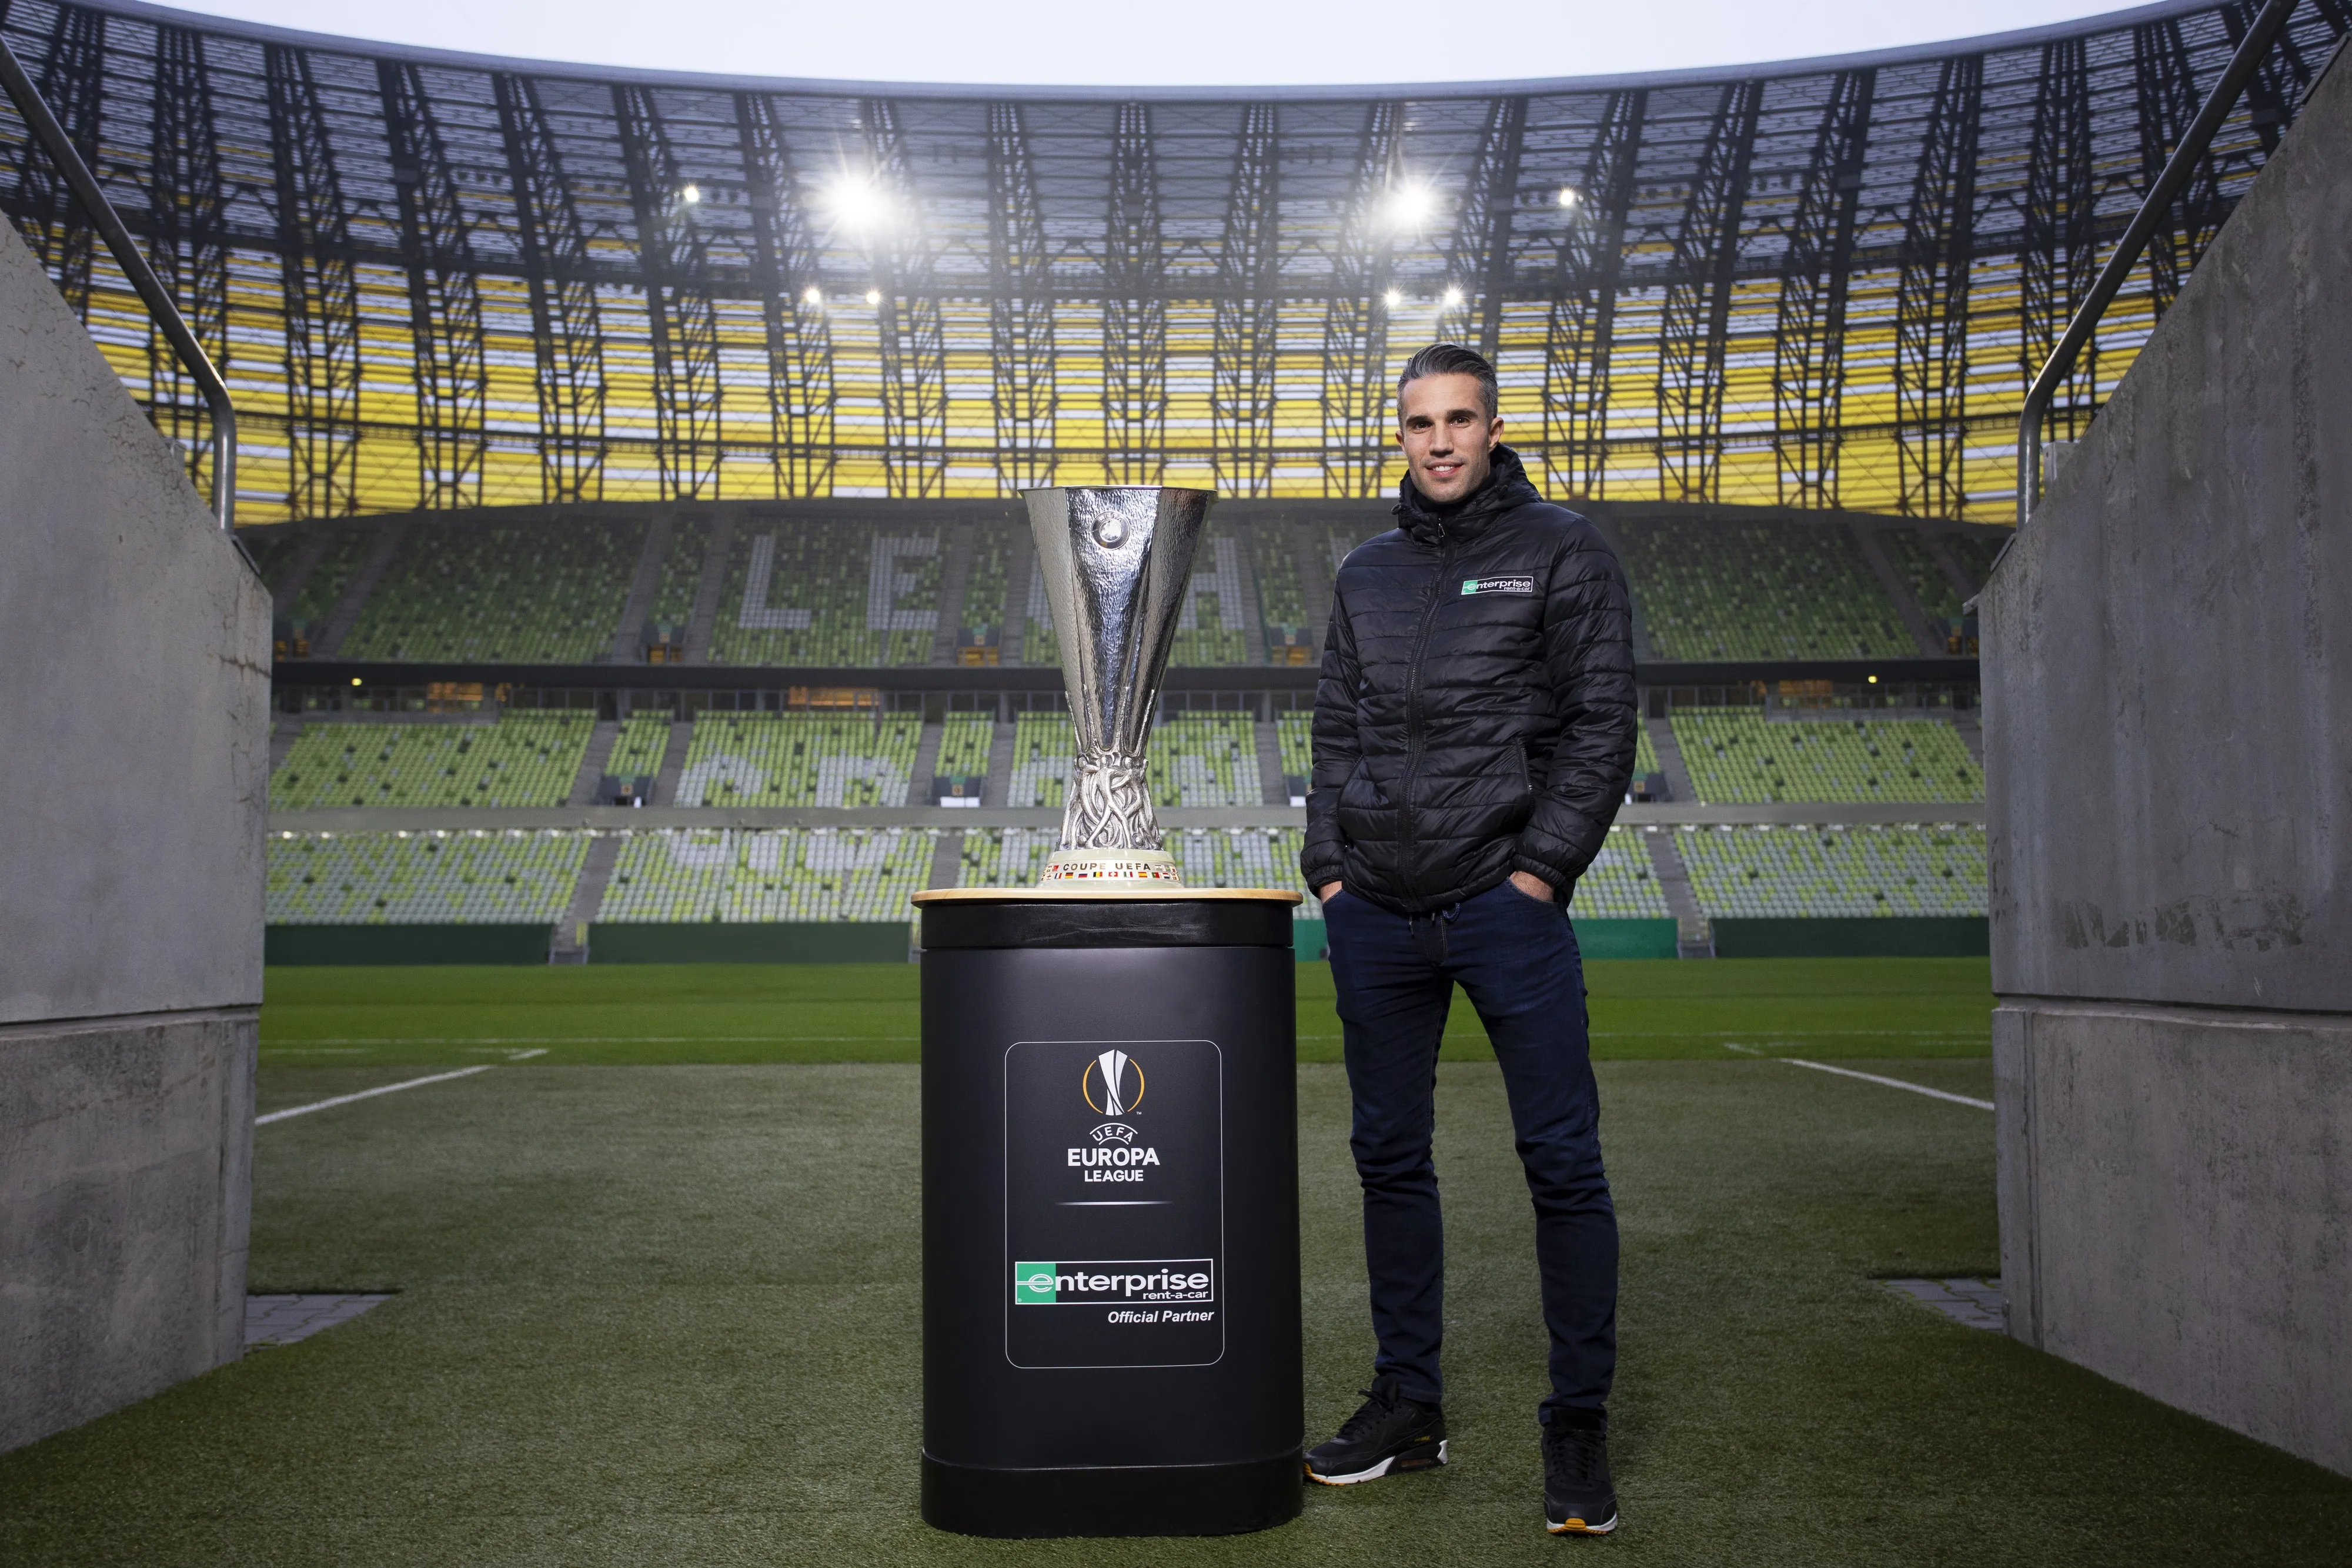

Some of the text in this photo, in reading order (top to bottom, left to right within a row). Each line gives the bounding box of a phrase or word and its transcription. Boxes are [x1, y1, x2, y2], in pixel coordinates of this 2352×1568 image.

[1098, 513, 1122, 522] UEFA
[1467, 579, 1531, 591] enterprise
[1092, 1126, 1134, 1142] UEFA
[1068, 1148, 1160, 1166] EUROPA
[1084, 1169, 1144, 1182] LEAGUE
[1028, 1268, 1209, 1297] enterprise
[1142, 1290, 1208, 1300] rent-a-car
[1108, 1310, 1215, 1323] Official Partner
